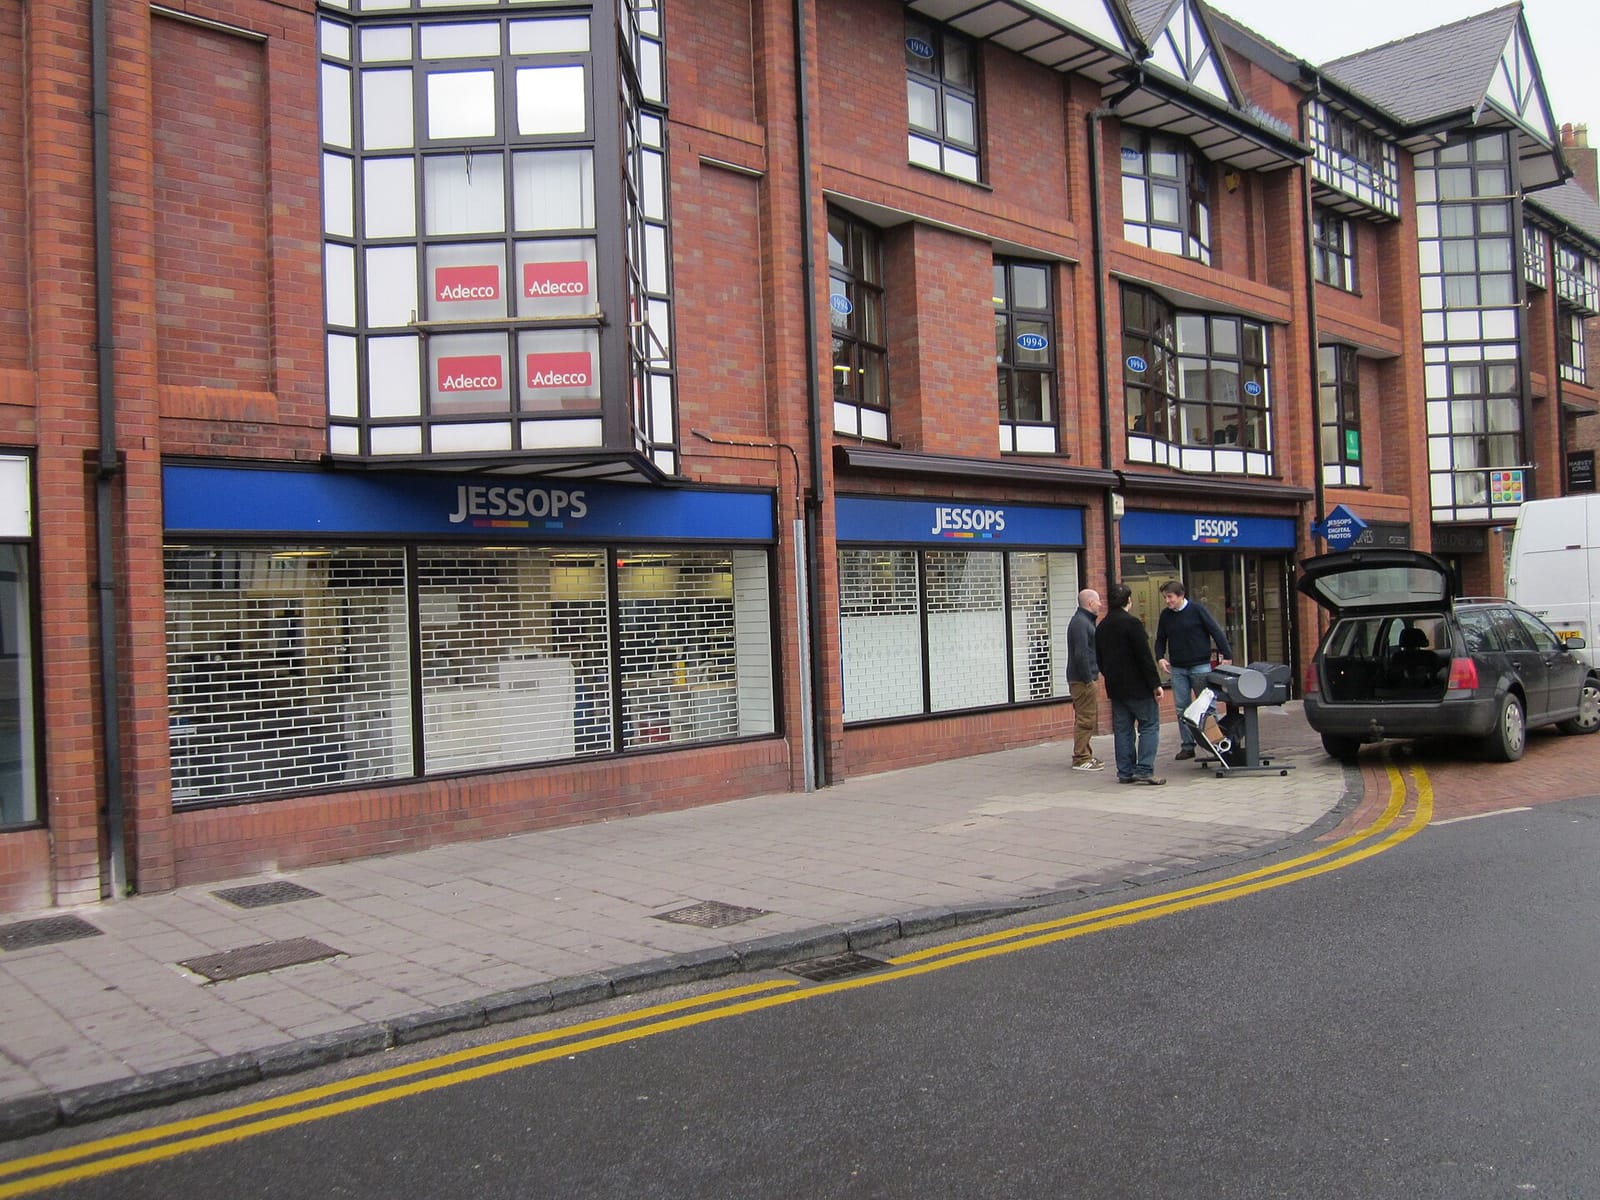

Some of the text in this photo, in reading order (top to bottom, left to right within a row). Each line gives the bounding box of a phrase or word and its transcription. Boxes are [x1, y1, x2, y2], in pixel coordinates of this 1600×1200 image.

[911, 40, 929, 56] 1994
[440, 285, 494, 299] Adecco
[528, 280, 584, 295] Adecco
[833, 295, 849, 310] 1994
[1022, 336, 1043, 348] 1994
[1130, 358, 1144, 370] 1994
[443, 374, 497, 389] Adecco
[531, 370, 587, 385] Adecco
[449, 485, 587, 523] JESSOPS
[931, 507, 1005, 535] JESSOPS
[1327, 518, 1352, 527] JESSOPS
[1192, 519, 1239, 541] JESSOPS
